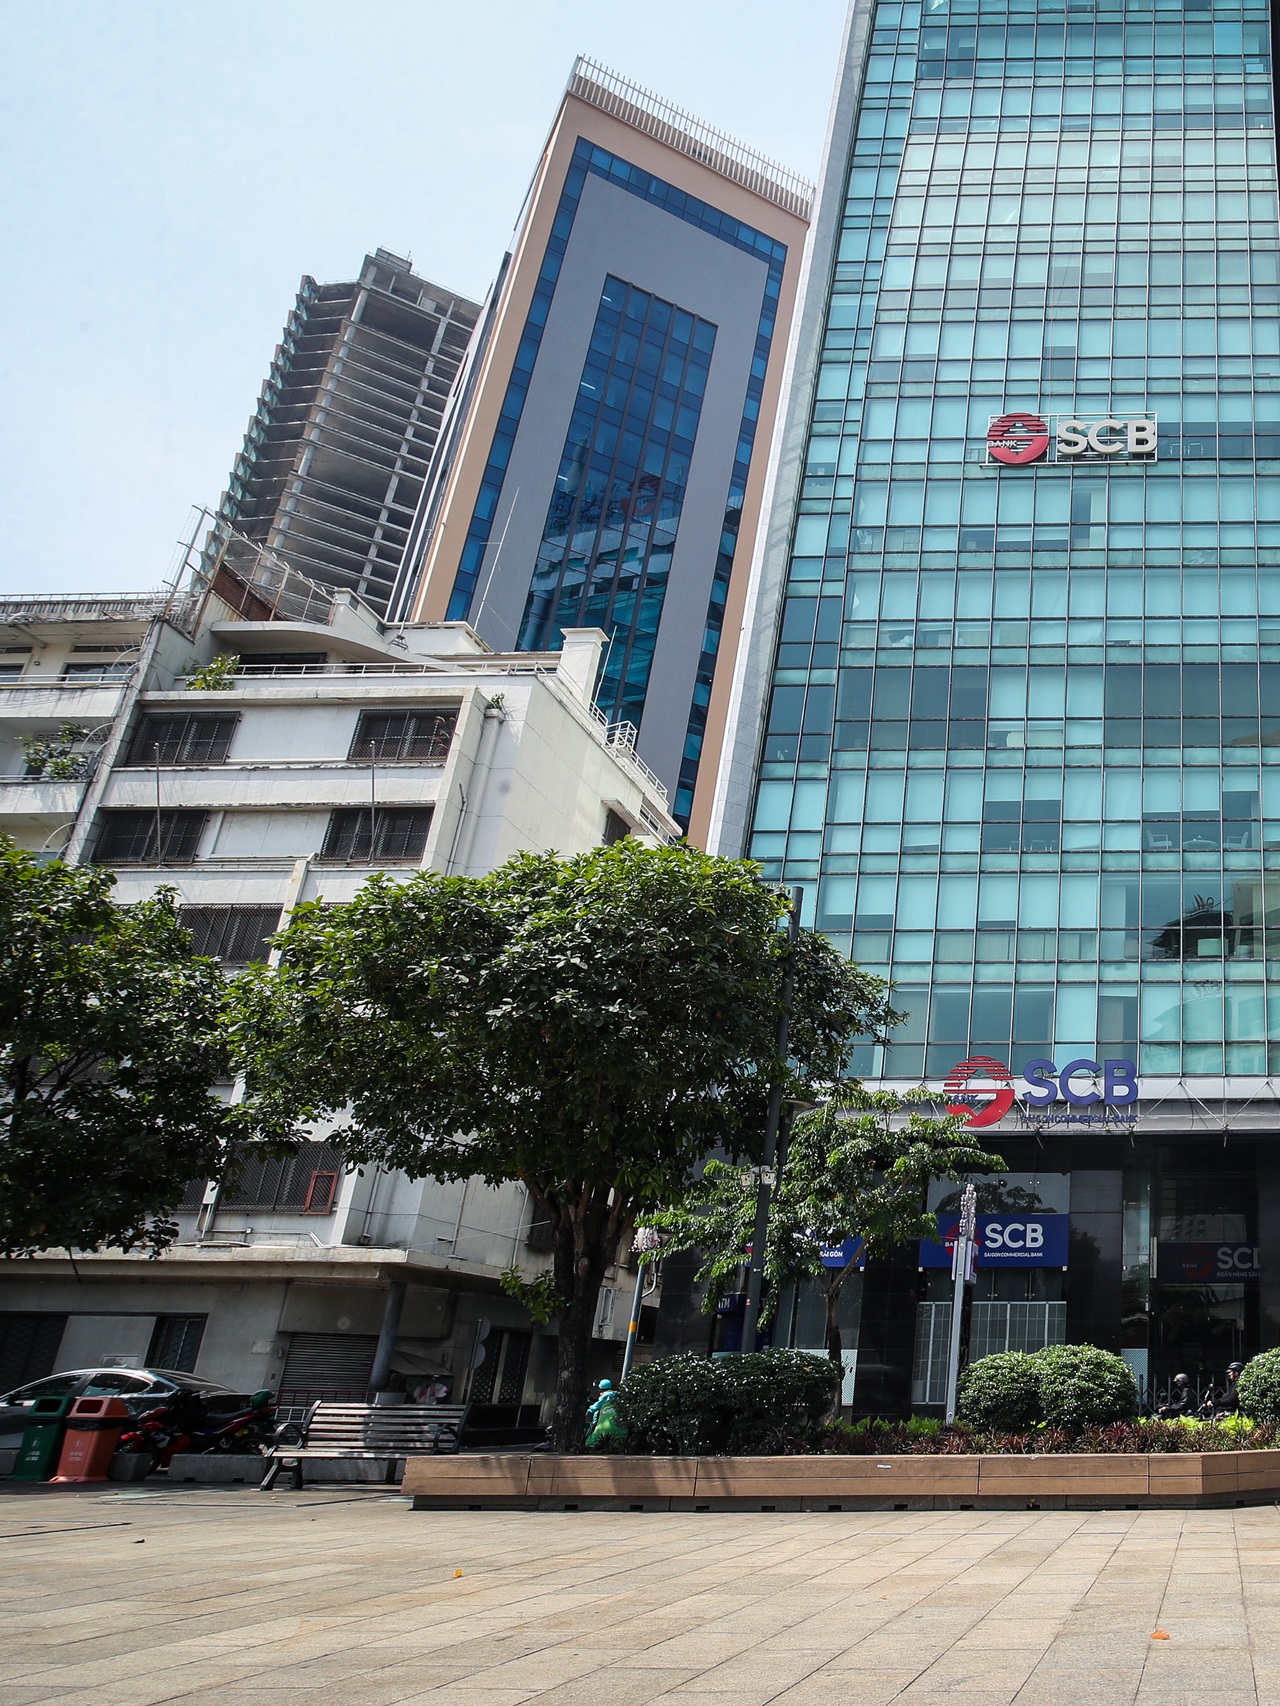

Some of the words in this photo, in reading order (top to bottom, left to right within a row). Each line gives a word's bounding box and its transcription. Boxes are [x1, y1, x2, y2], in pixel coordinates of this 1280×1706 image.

[1057, 418, 1157, 455] SCB
[1022, 1058, 1139, 1106] SCB
[951, 1093, 979, 1104] ANK
[984, 1223, 1044, 1248] SCB
